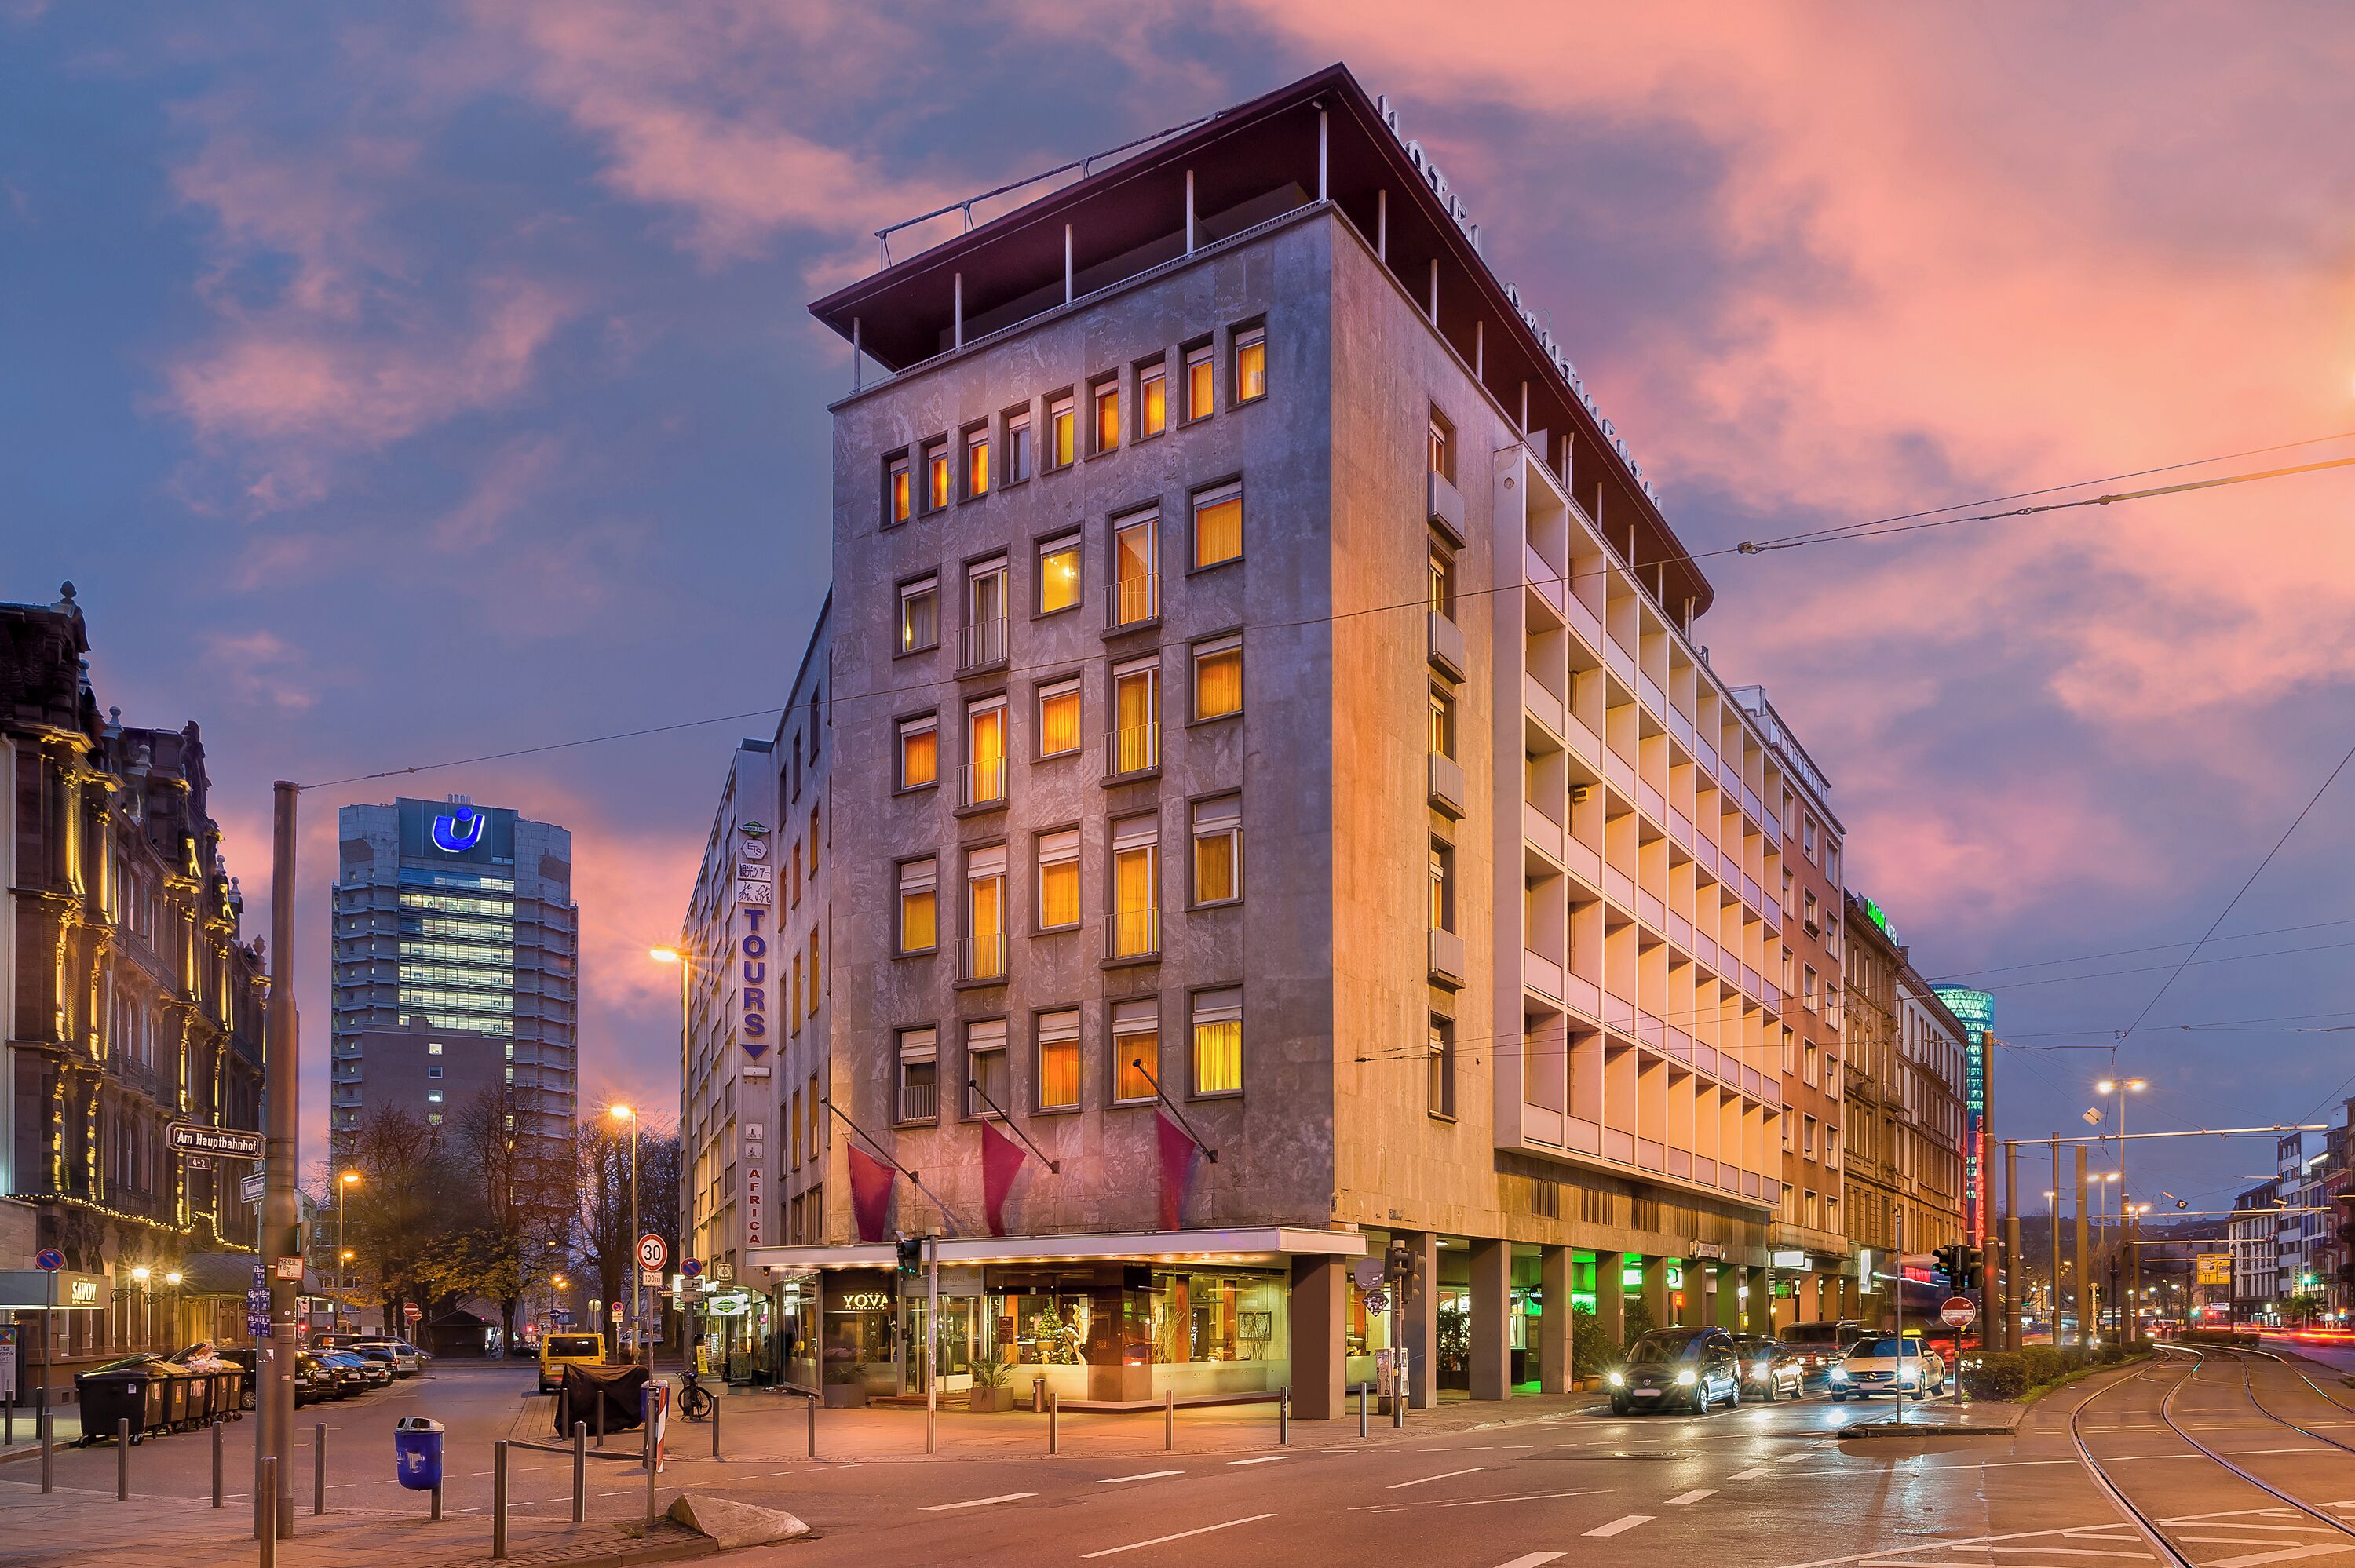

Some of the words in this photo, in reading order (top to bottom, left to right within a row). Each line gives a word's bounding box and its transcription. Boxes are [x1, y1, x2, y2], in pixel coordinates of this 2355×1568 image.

[747, 842, 762, 856] ETS
[743, 909, 766, 1037] TOURS
[177, 1131, 193, 1144] Am
[196, 1133, 257, 1152] Hauptbahnhof
[192, 1158, 206, 1168] 4-2
[749, 1169, 761, 1244] AFRICA
[644, 1245, 661, 1261] 30
[72, 1281, 97, 1300] SAVOY
